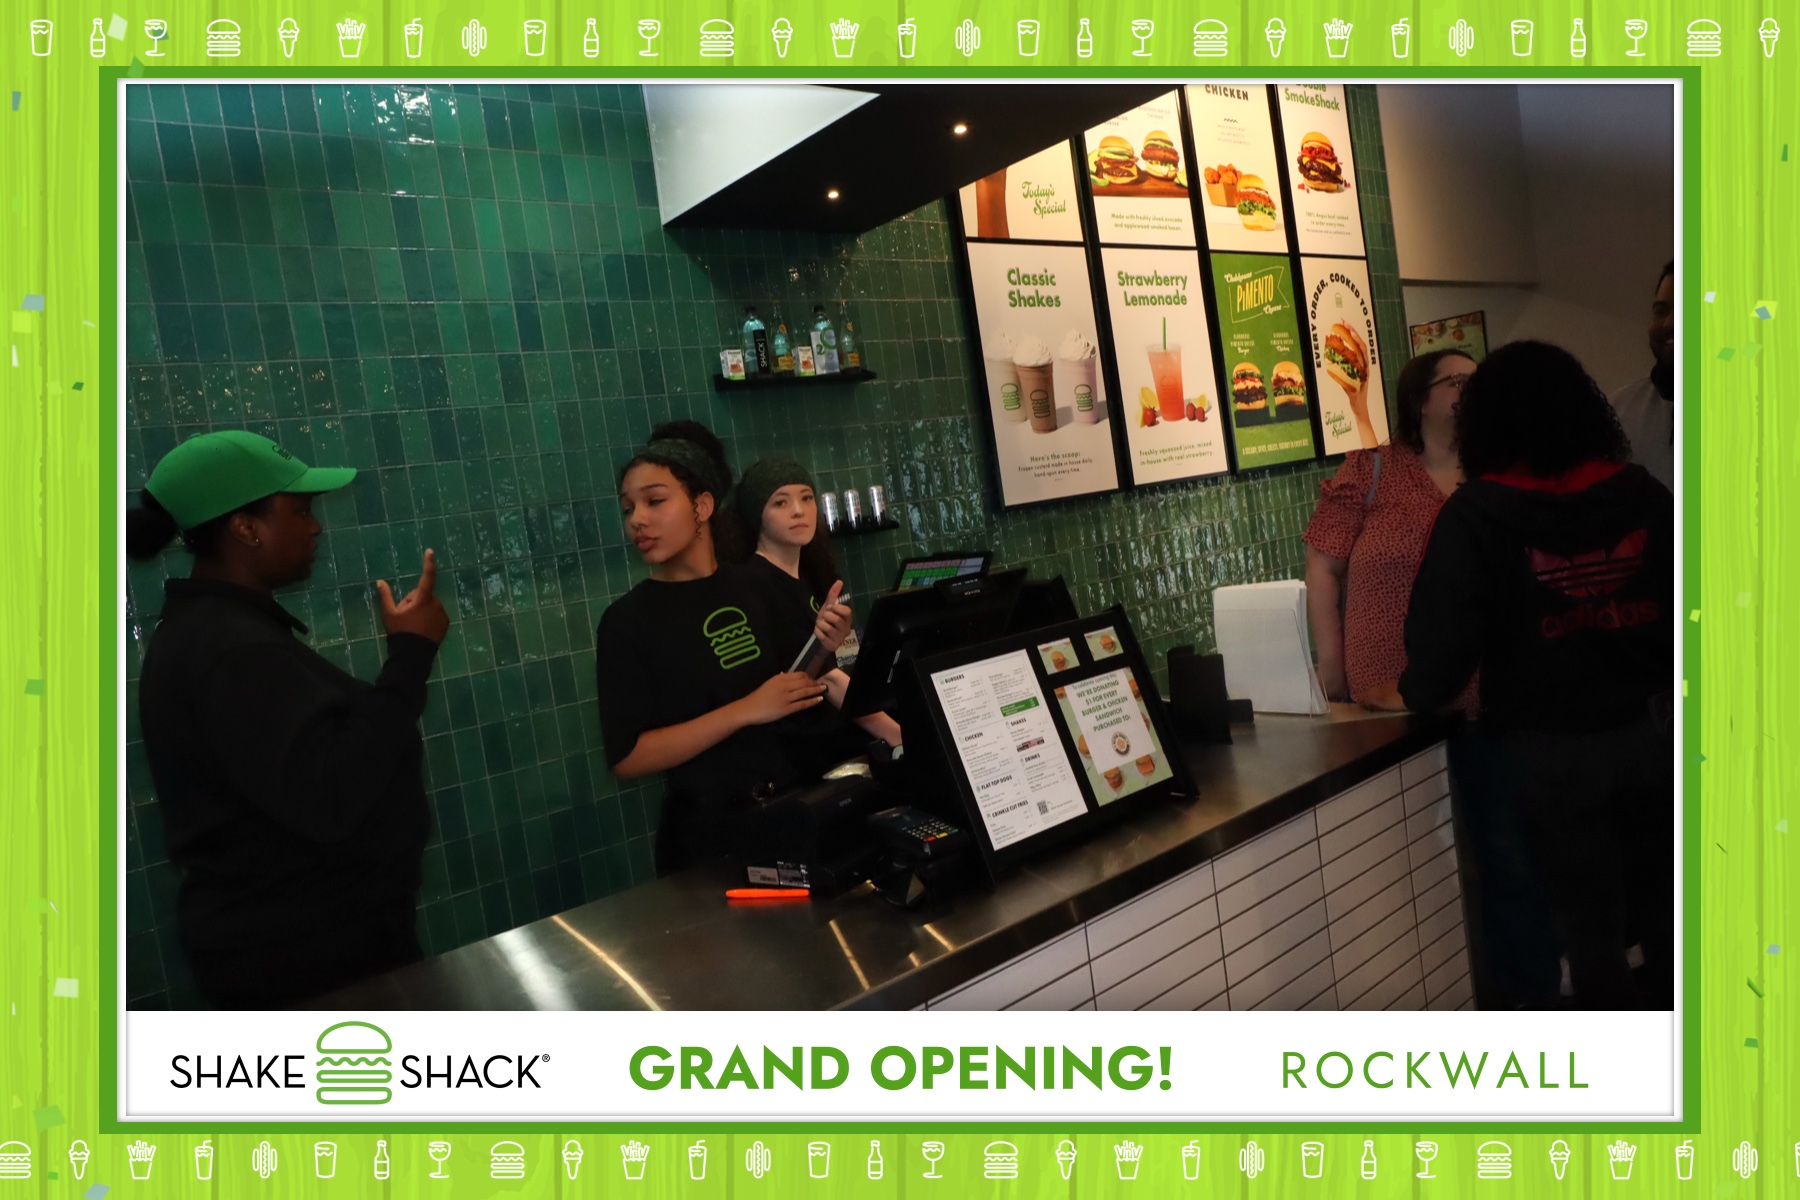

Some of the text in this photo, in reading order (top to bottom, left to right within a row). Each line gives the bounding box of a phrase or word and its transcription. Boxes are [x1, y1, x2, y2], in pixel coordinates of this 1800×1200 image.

[1205, 84, 1249, 101] CHICKEN
[1285, 88, 1340, 111] SmokeShack
[1022, 181, 1055, 204] Today's
[1033, 199, 1066, 219] Special
[1007, 267, 1056, 286] Classic
[1117, 270, 1188, 291] Strawberry
[1008, 289, 1061, 308] Shakes
[1124, 290, 1187, 307] Lemonade
[1311, 323, 1321, 368] EVERY
[1330, 272, 1360, 298] COOKED
[1360, 298, 1368, 316] TO
[1366, 319, 1376, 365] ORDER
[758, 342, 767, 367] SHACK
[1332, 421, 1352, 440] Special
[1140, 448, 1158, 456] Freshly
[1159, 445, 1182, 454] squeezed
[1197, 440, 1212, 448] mixed
[1030, 454, 1050, 463] Here's
[1051, 452, 1060, 460] the
[1541, 599, 1660, 638] adidas
[945, 674, 965, 684] BURGERS
[1076, 680, 1119, 698] WE'RE DONATING
[1093, 694, 1103, 703] FOR
[1103, 690, 1118, 699] EVERY
[1081, 704, 1102, 716] BURGER
[1107, 696, 1128, 707] CHICKEN
[1095, 707, 1123, 721] SANDWICH
[1011, 718, 1027, 727] SHAKES
[1093, 717, 1123, 732] PURCHASED
[964, 731, 984, 741] CHICKEN
[1024, 753, 1040, 762] DRINKS
[981, 775, 1012, 790] FLAT TOP DOGS
[992, 806, 1010, 818] CRINKLE
[1017, 800, 1029, 808] FRIES
